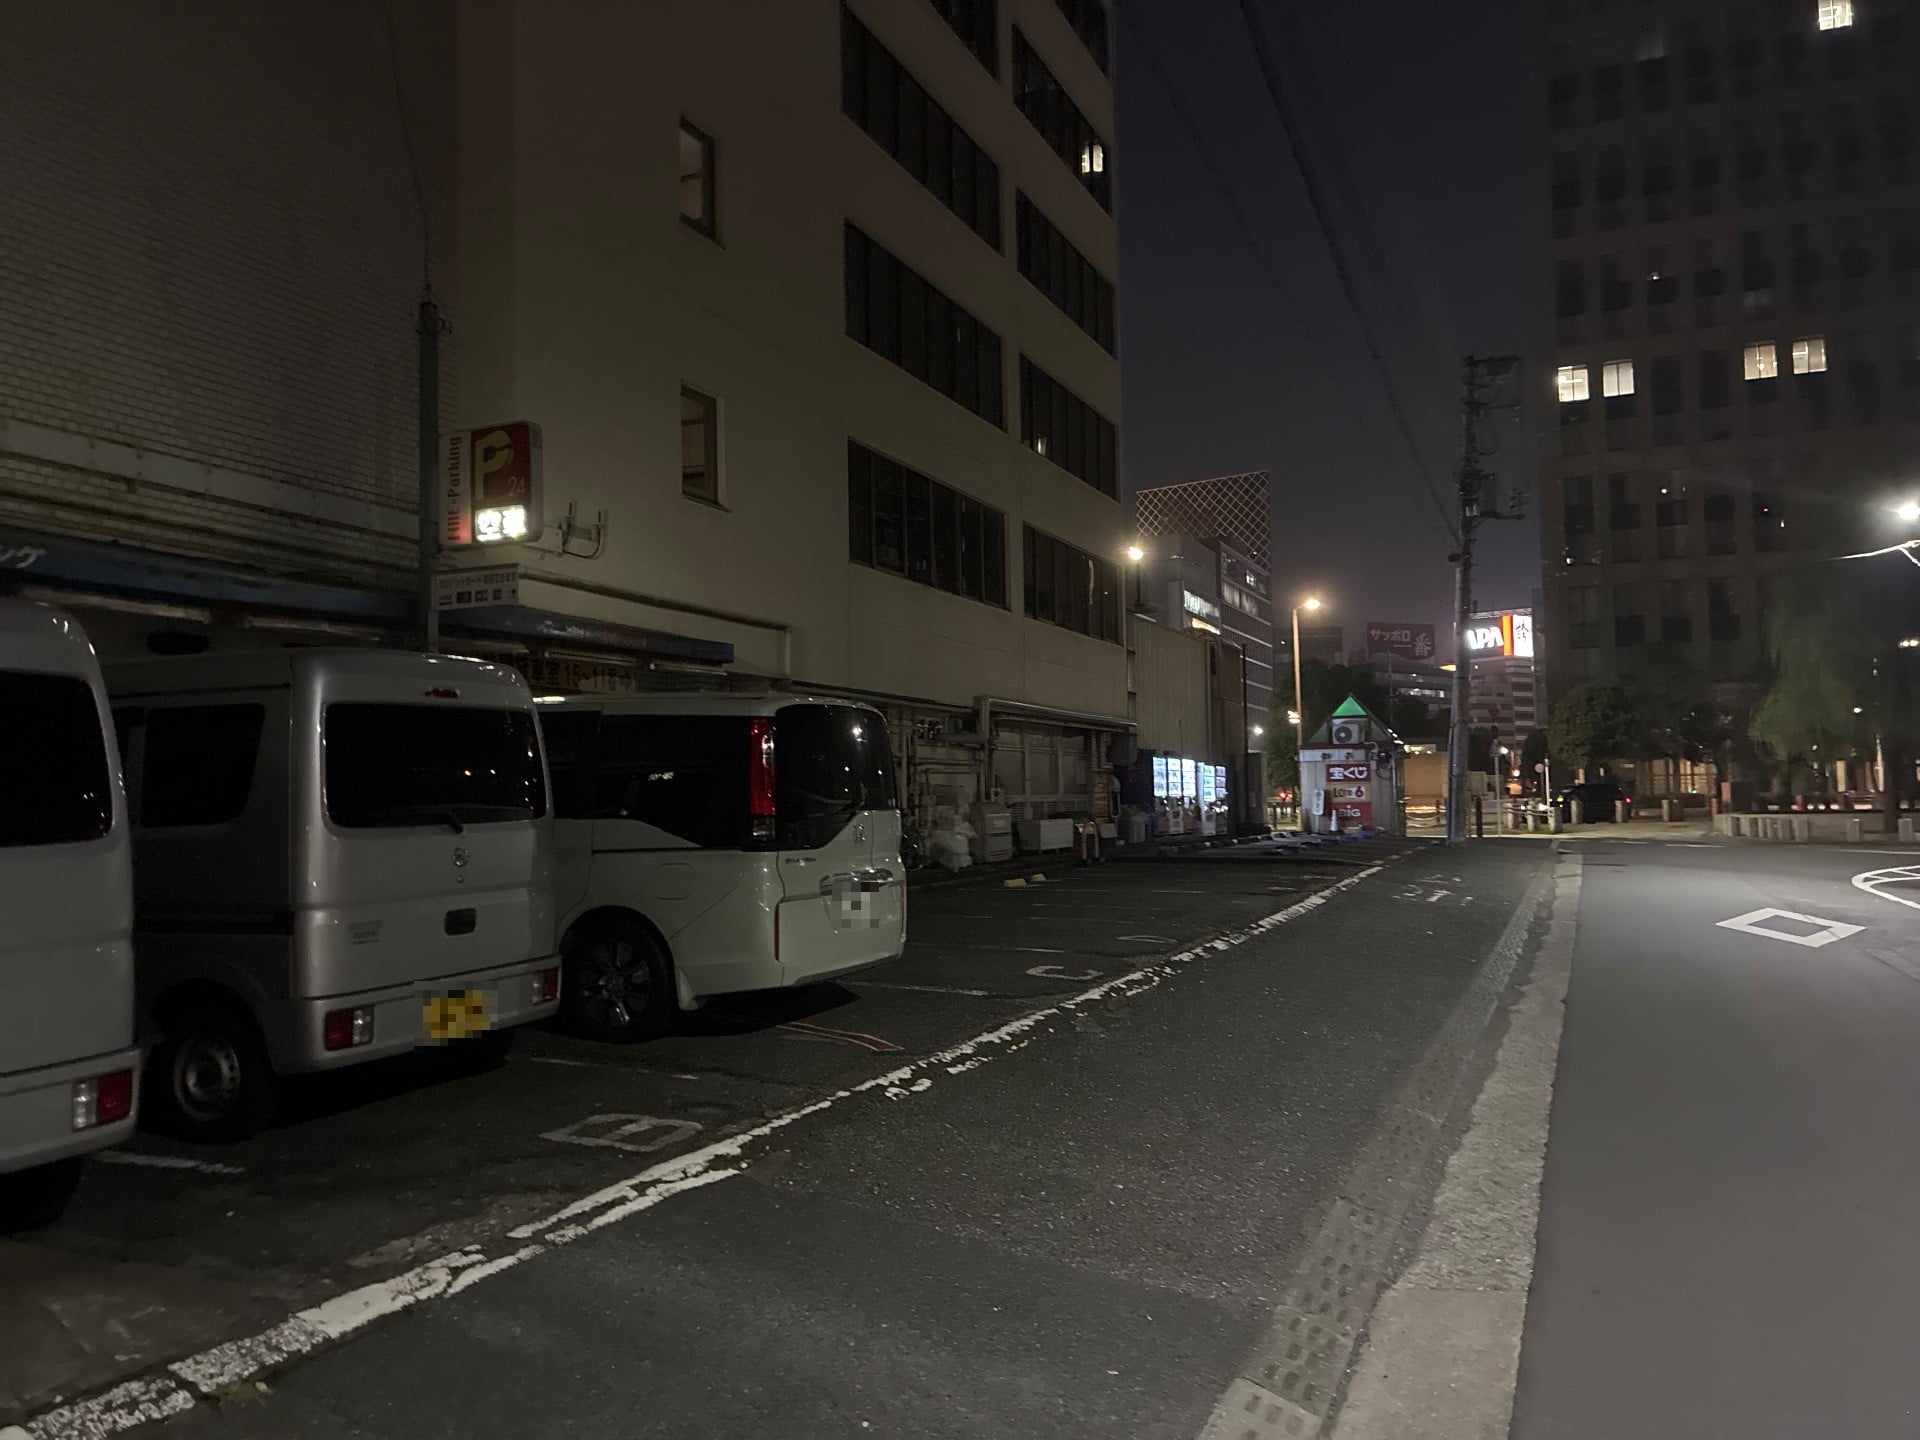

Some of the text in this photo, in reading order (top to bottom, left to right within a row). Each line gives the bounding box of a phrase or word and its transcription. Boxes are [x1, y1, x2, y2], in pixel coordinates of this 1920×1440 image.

[1329, 766, 1368, 779] 宝くじ
[1355, 785, 1364, 798] 6
